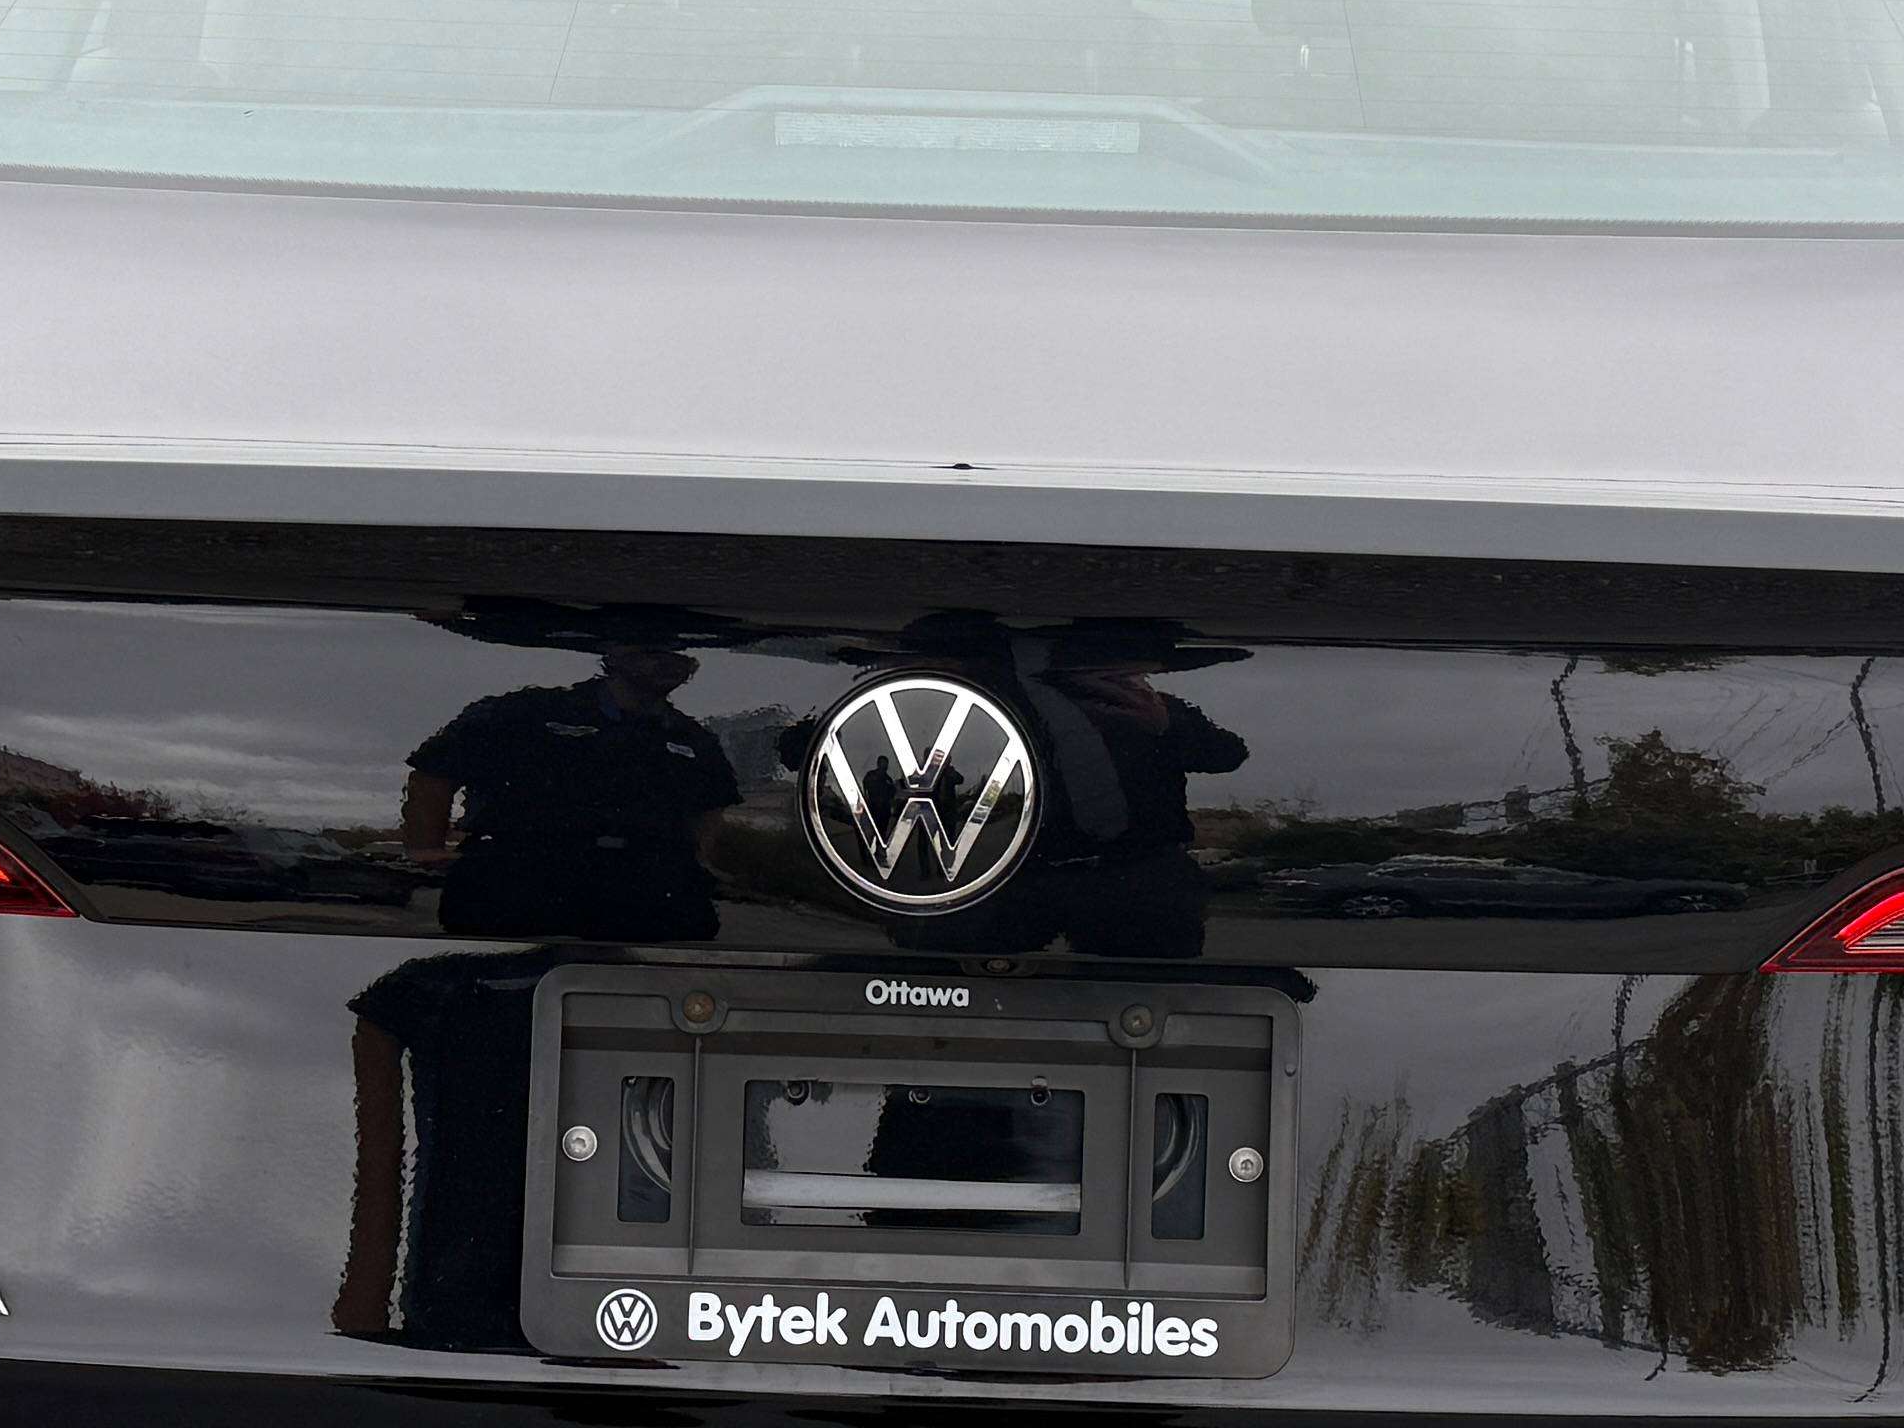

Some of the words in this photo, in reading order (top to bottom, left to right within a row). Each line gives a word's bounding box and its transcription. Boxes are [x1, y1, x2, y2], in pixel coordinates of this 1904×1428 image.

[807, 678, 1035, 905] VW
[865, 979, 970, 1007] Ottawa
[596, 1288, 658, 1351] VW
[687, 1291, 848, 1357] Bytek
[863, 1296, 1219, 1358] Automobiles
